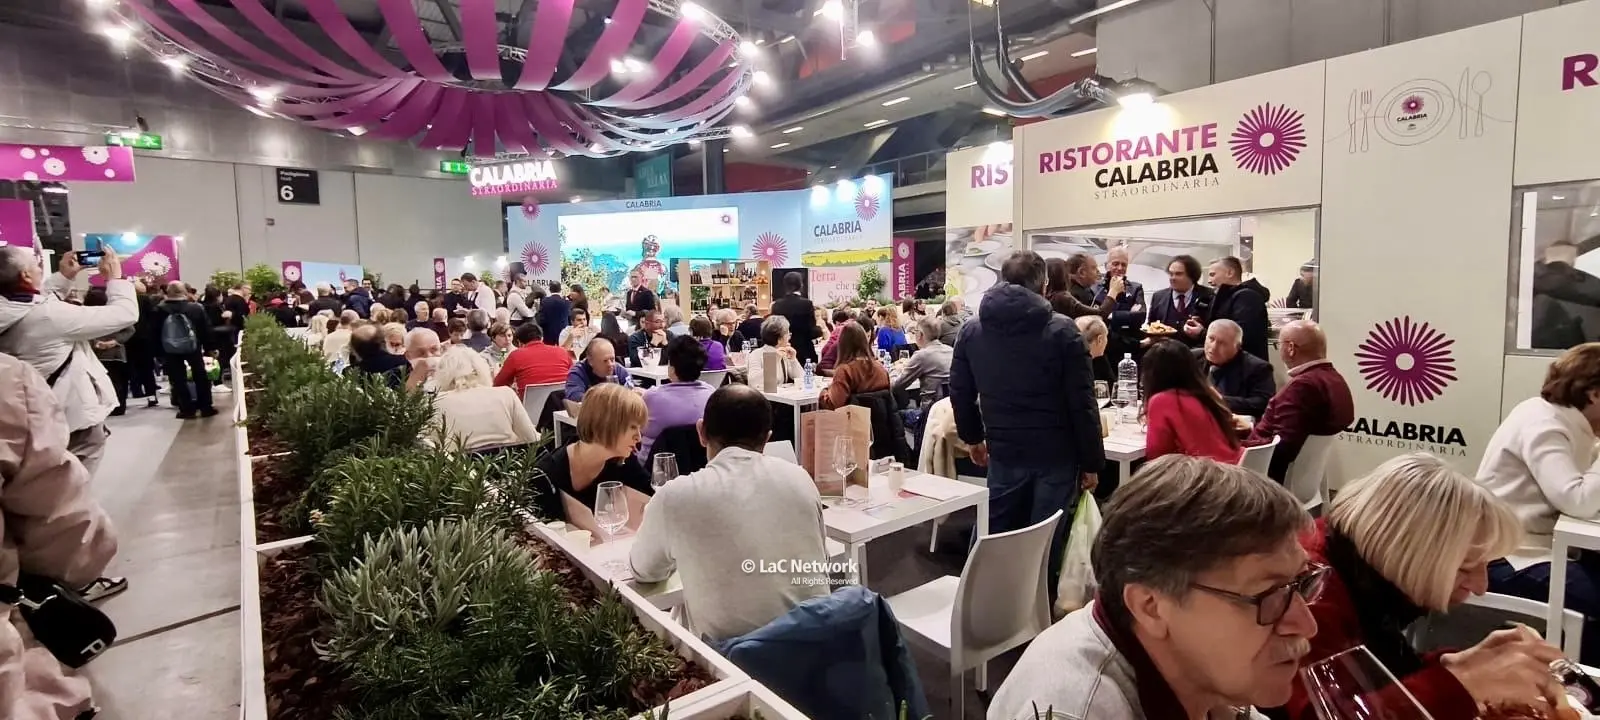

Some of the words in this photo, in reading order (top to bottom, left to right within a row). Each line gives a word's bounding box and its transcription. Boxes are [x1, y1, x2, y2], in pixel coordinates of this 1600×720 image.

[1396, 113, 1428, 122] CALABRIA
[1039, 123, 1218, 174] RISTORANTE
[470, 160, 557, 188] CALABRIA
[971, 162, 1013, 188] RIS
[1094, 152, 1219, 188] CALABRIA
[280, 185, 294, 201] 6
[471, 180, 558, 196] STRAORDINARIA
[1094, 176, 1220, 200] STRAORDINARIA
[625, 200, 662, 208] CALABRIA
[813, 220, 862, 237] CALABRIA
[811, 269, 836, 282] Terra
[1343, 417, 1467, 446] ALABRIA
[1339, 433, 1466, 456] STRAORDINARIA
